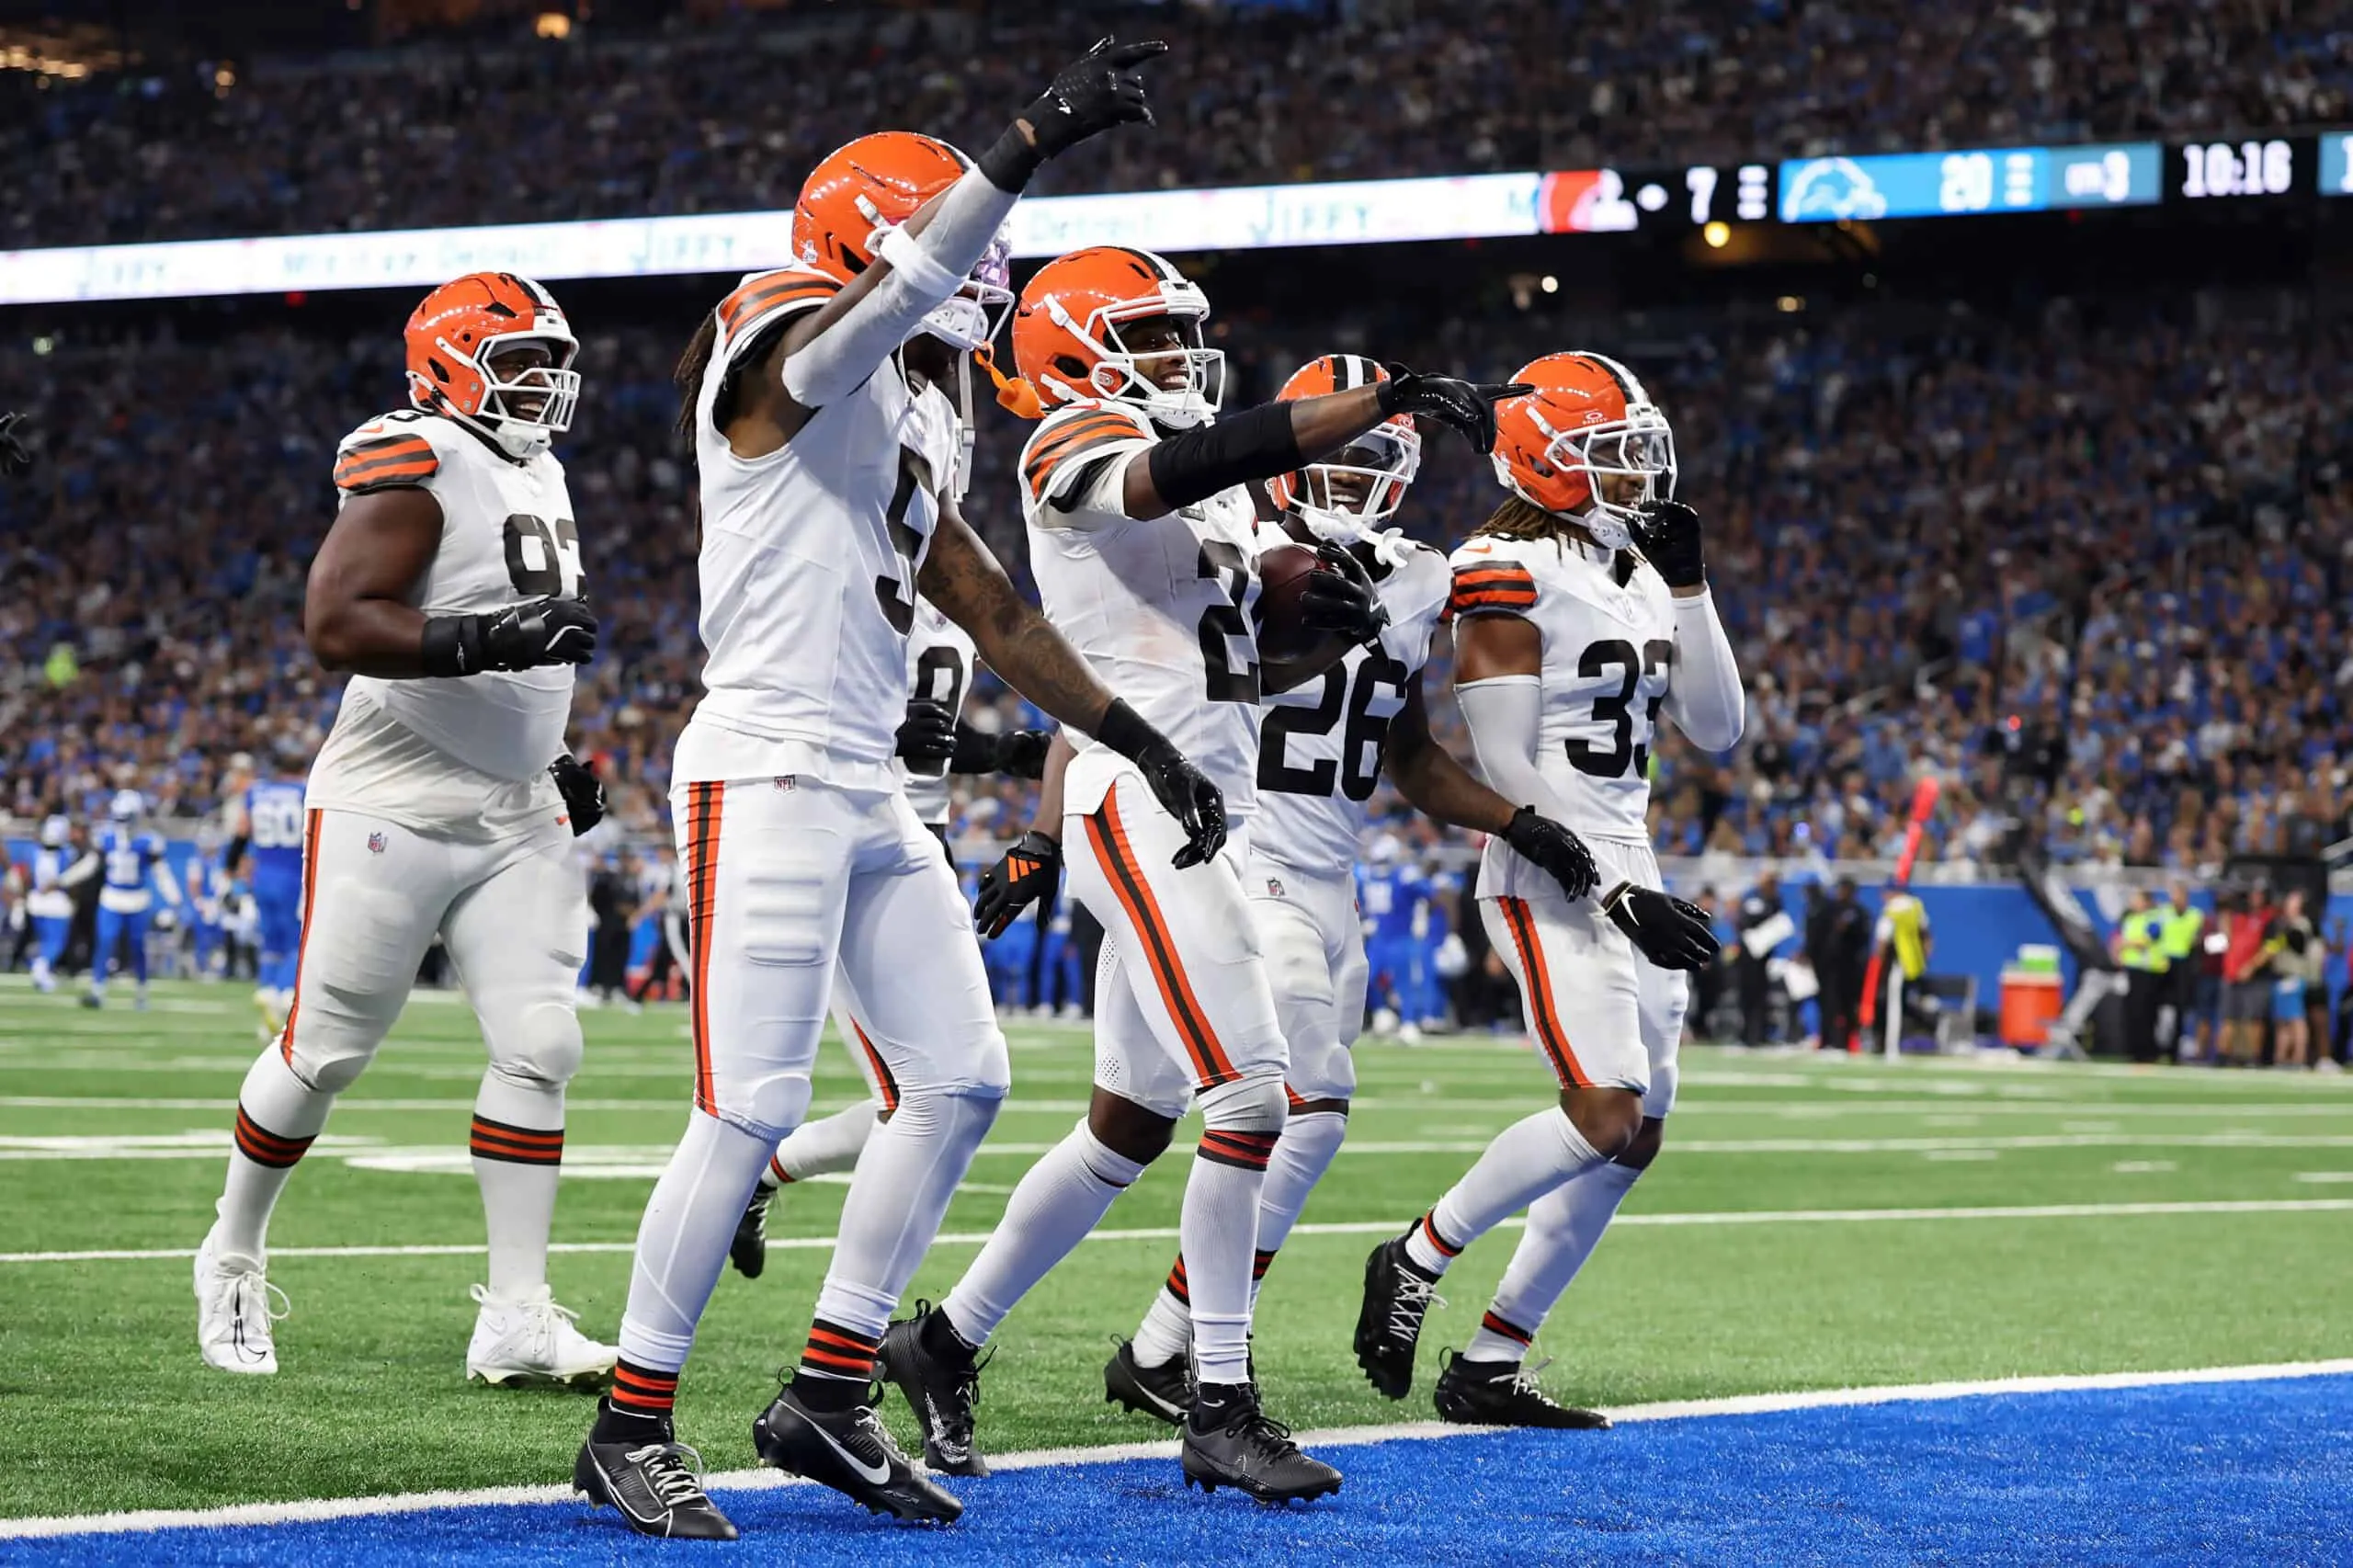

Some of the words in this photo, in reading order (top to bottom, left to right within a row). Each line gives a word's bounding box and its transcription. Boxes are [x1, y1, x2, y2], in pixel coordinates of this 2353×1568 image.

[1246, 190, 1373, 243] JIFFY
[1687, 166, 1718, 223] 7
[1941, 154, 1993, 210] 20
[2182, 141, 2292, 198] 10:16
[875, 443, 939, 636] 5
[1199, 540, 1261, 706] 2
[1257, 656, 1410, 802] 26
[1565, 639, 1673, 779] 33
